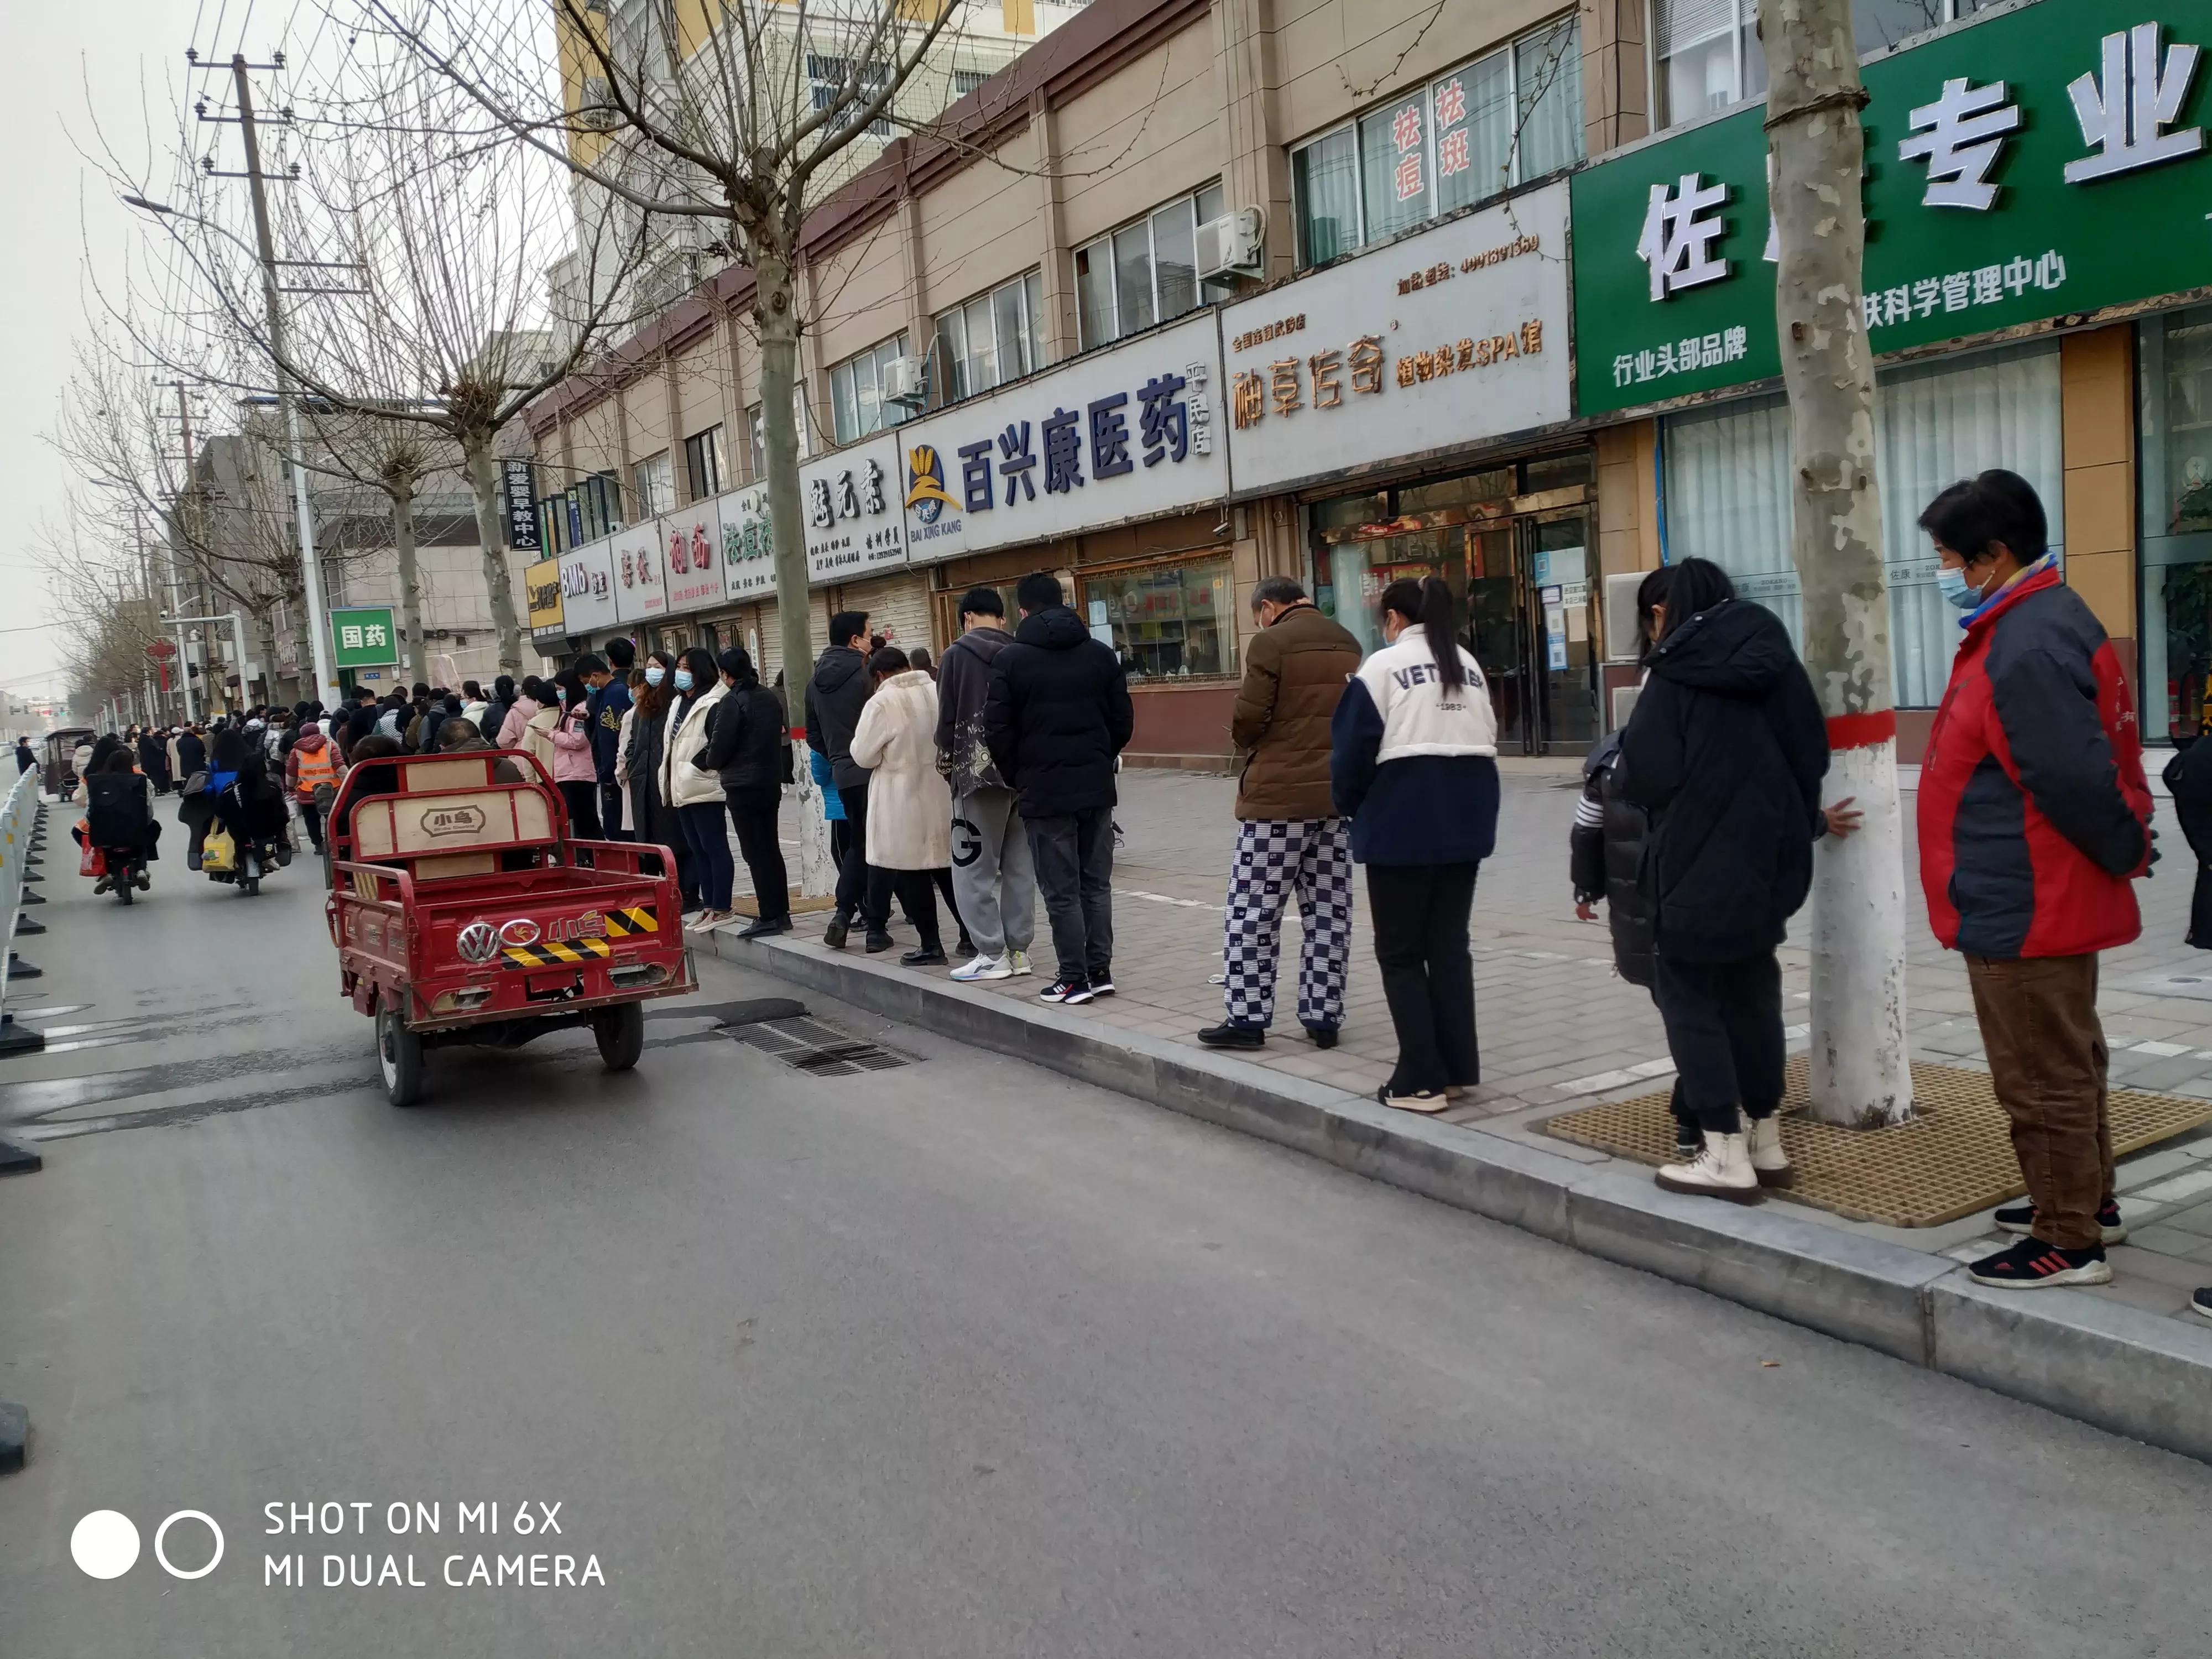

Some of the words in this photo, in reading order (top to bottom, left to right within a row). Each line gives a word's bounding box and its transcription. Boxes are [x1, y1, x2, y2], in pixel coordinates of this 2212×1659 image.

[1392, 104, 1425, 202] 祛痘
[1434, 78, 1471, 178] 祛斑
[1232, 334, 1384, 431] 神草传奇
[1396, 318, 1543, 389] 植物染发SPA馆
[1611, 324, 1747, 388] 行业头部品牌
[1185, 360, 1211, 456] 平民店
[957, 373, 1188, 514] 百兴康医药
[506, 461, 537, 547] 新爱婴早教中心
[810, 458, 886, 528] 魅元素
[910, 529, 922, 543] BAI
[923, 524, 940, 540] XING
[941, 519, 962, 536] KANG
[1890, 568, 1911, 580] 佐康
[341, 624, 387, 649] 国药
[434, 811, 472, 826] 小鸟
[951, 818, 982, 867] G
